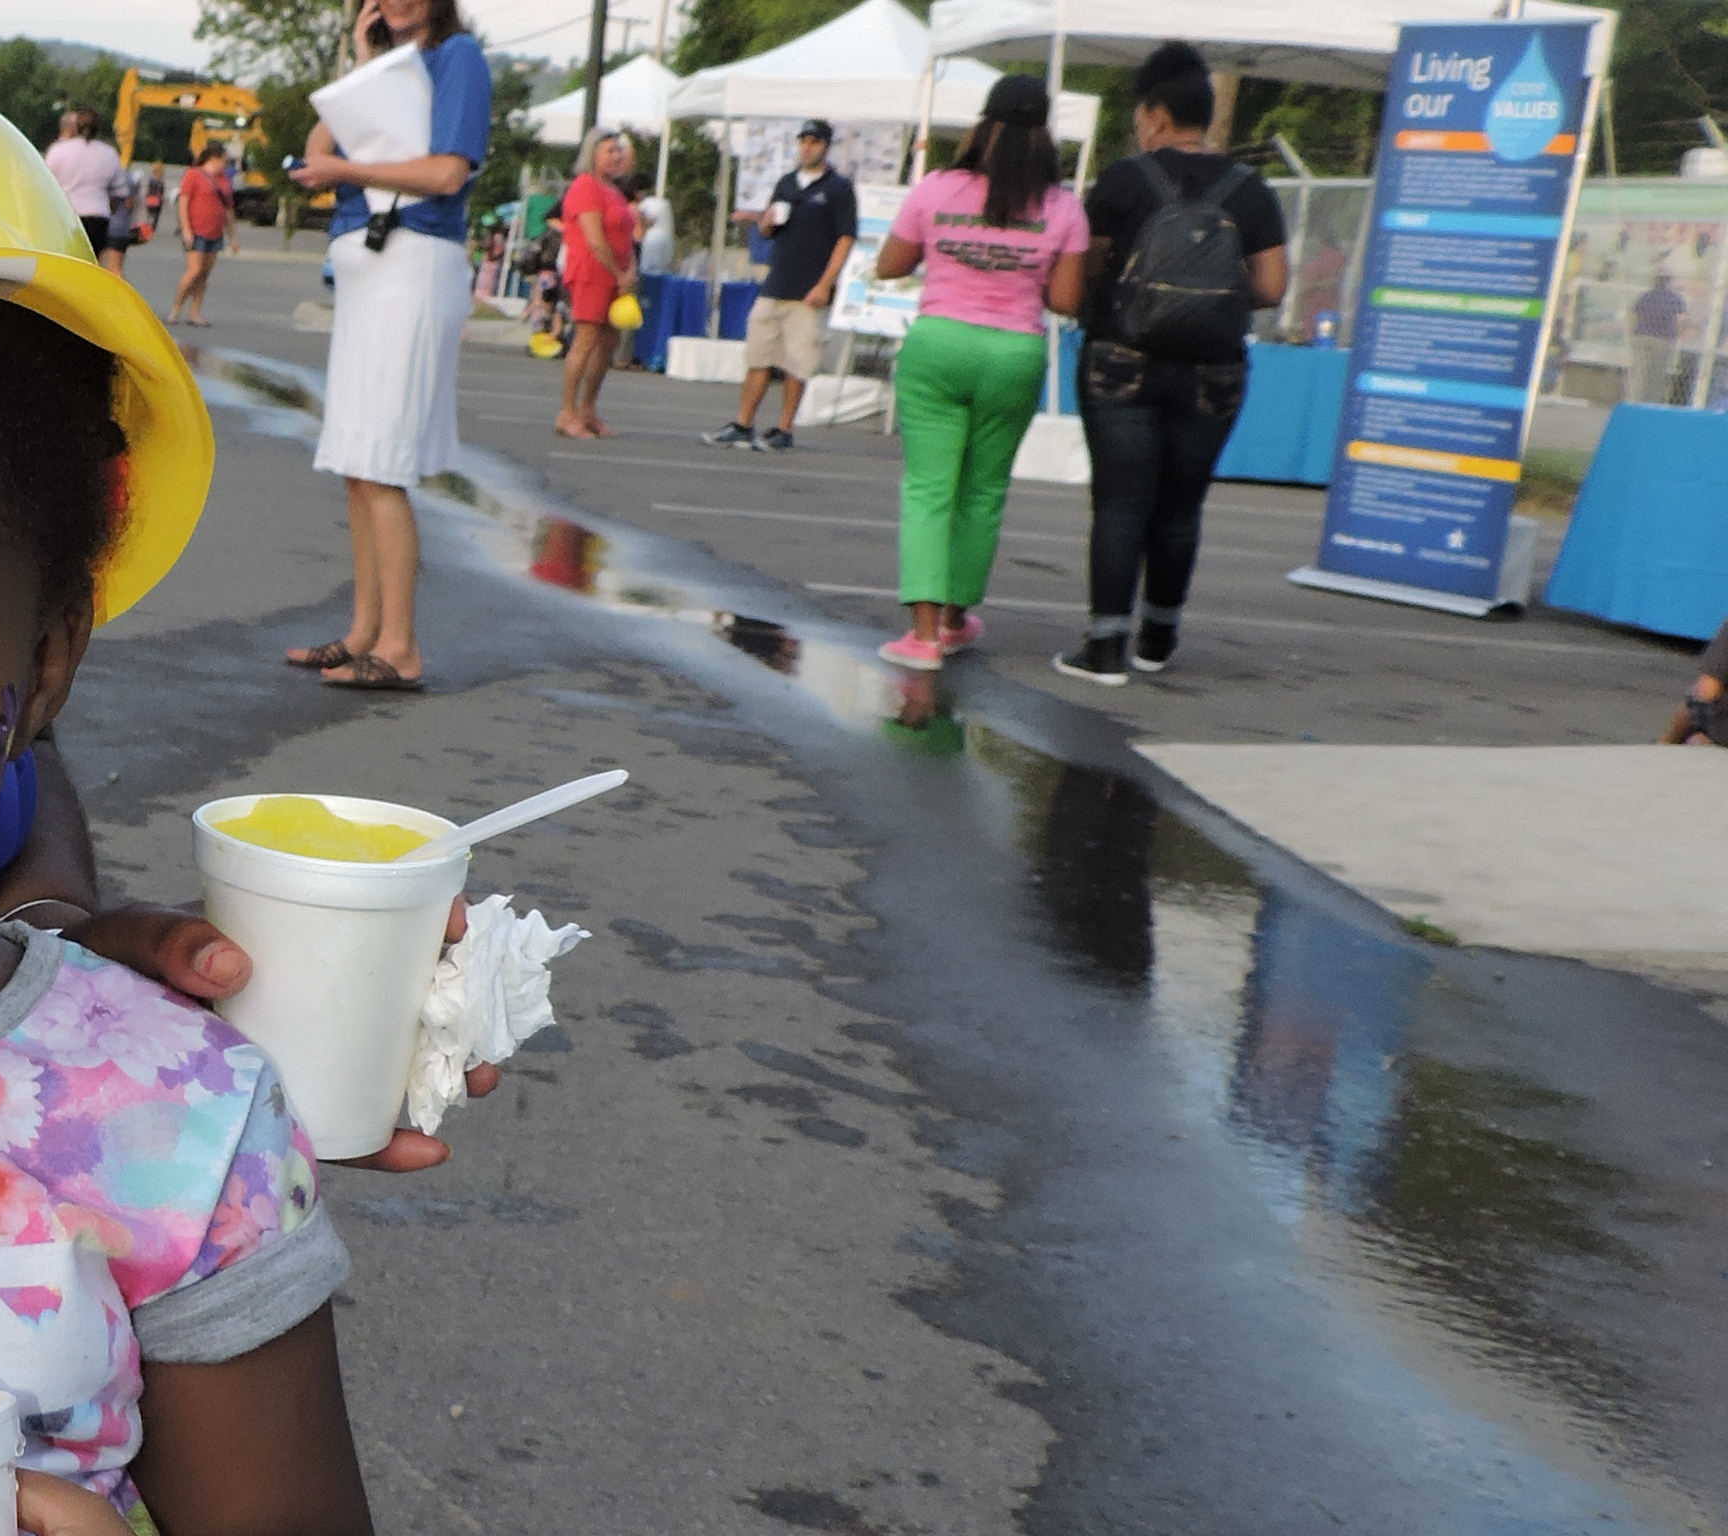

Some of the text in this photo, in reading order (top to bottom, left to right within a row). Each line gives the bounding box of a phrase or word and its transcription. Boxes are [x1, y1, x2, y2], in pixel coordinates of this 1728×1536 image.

[1410, 51, 1493, 91] Living
[1404, 92, 1455, 118] our
[1493, 100, 1559, 119] VALUES
